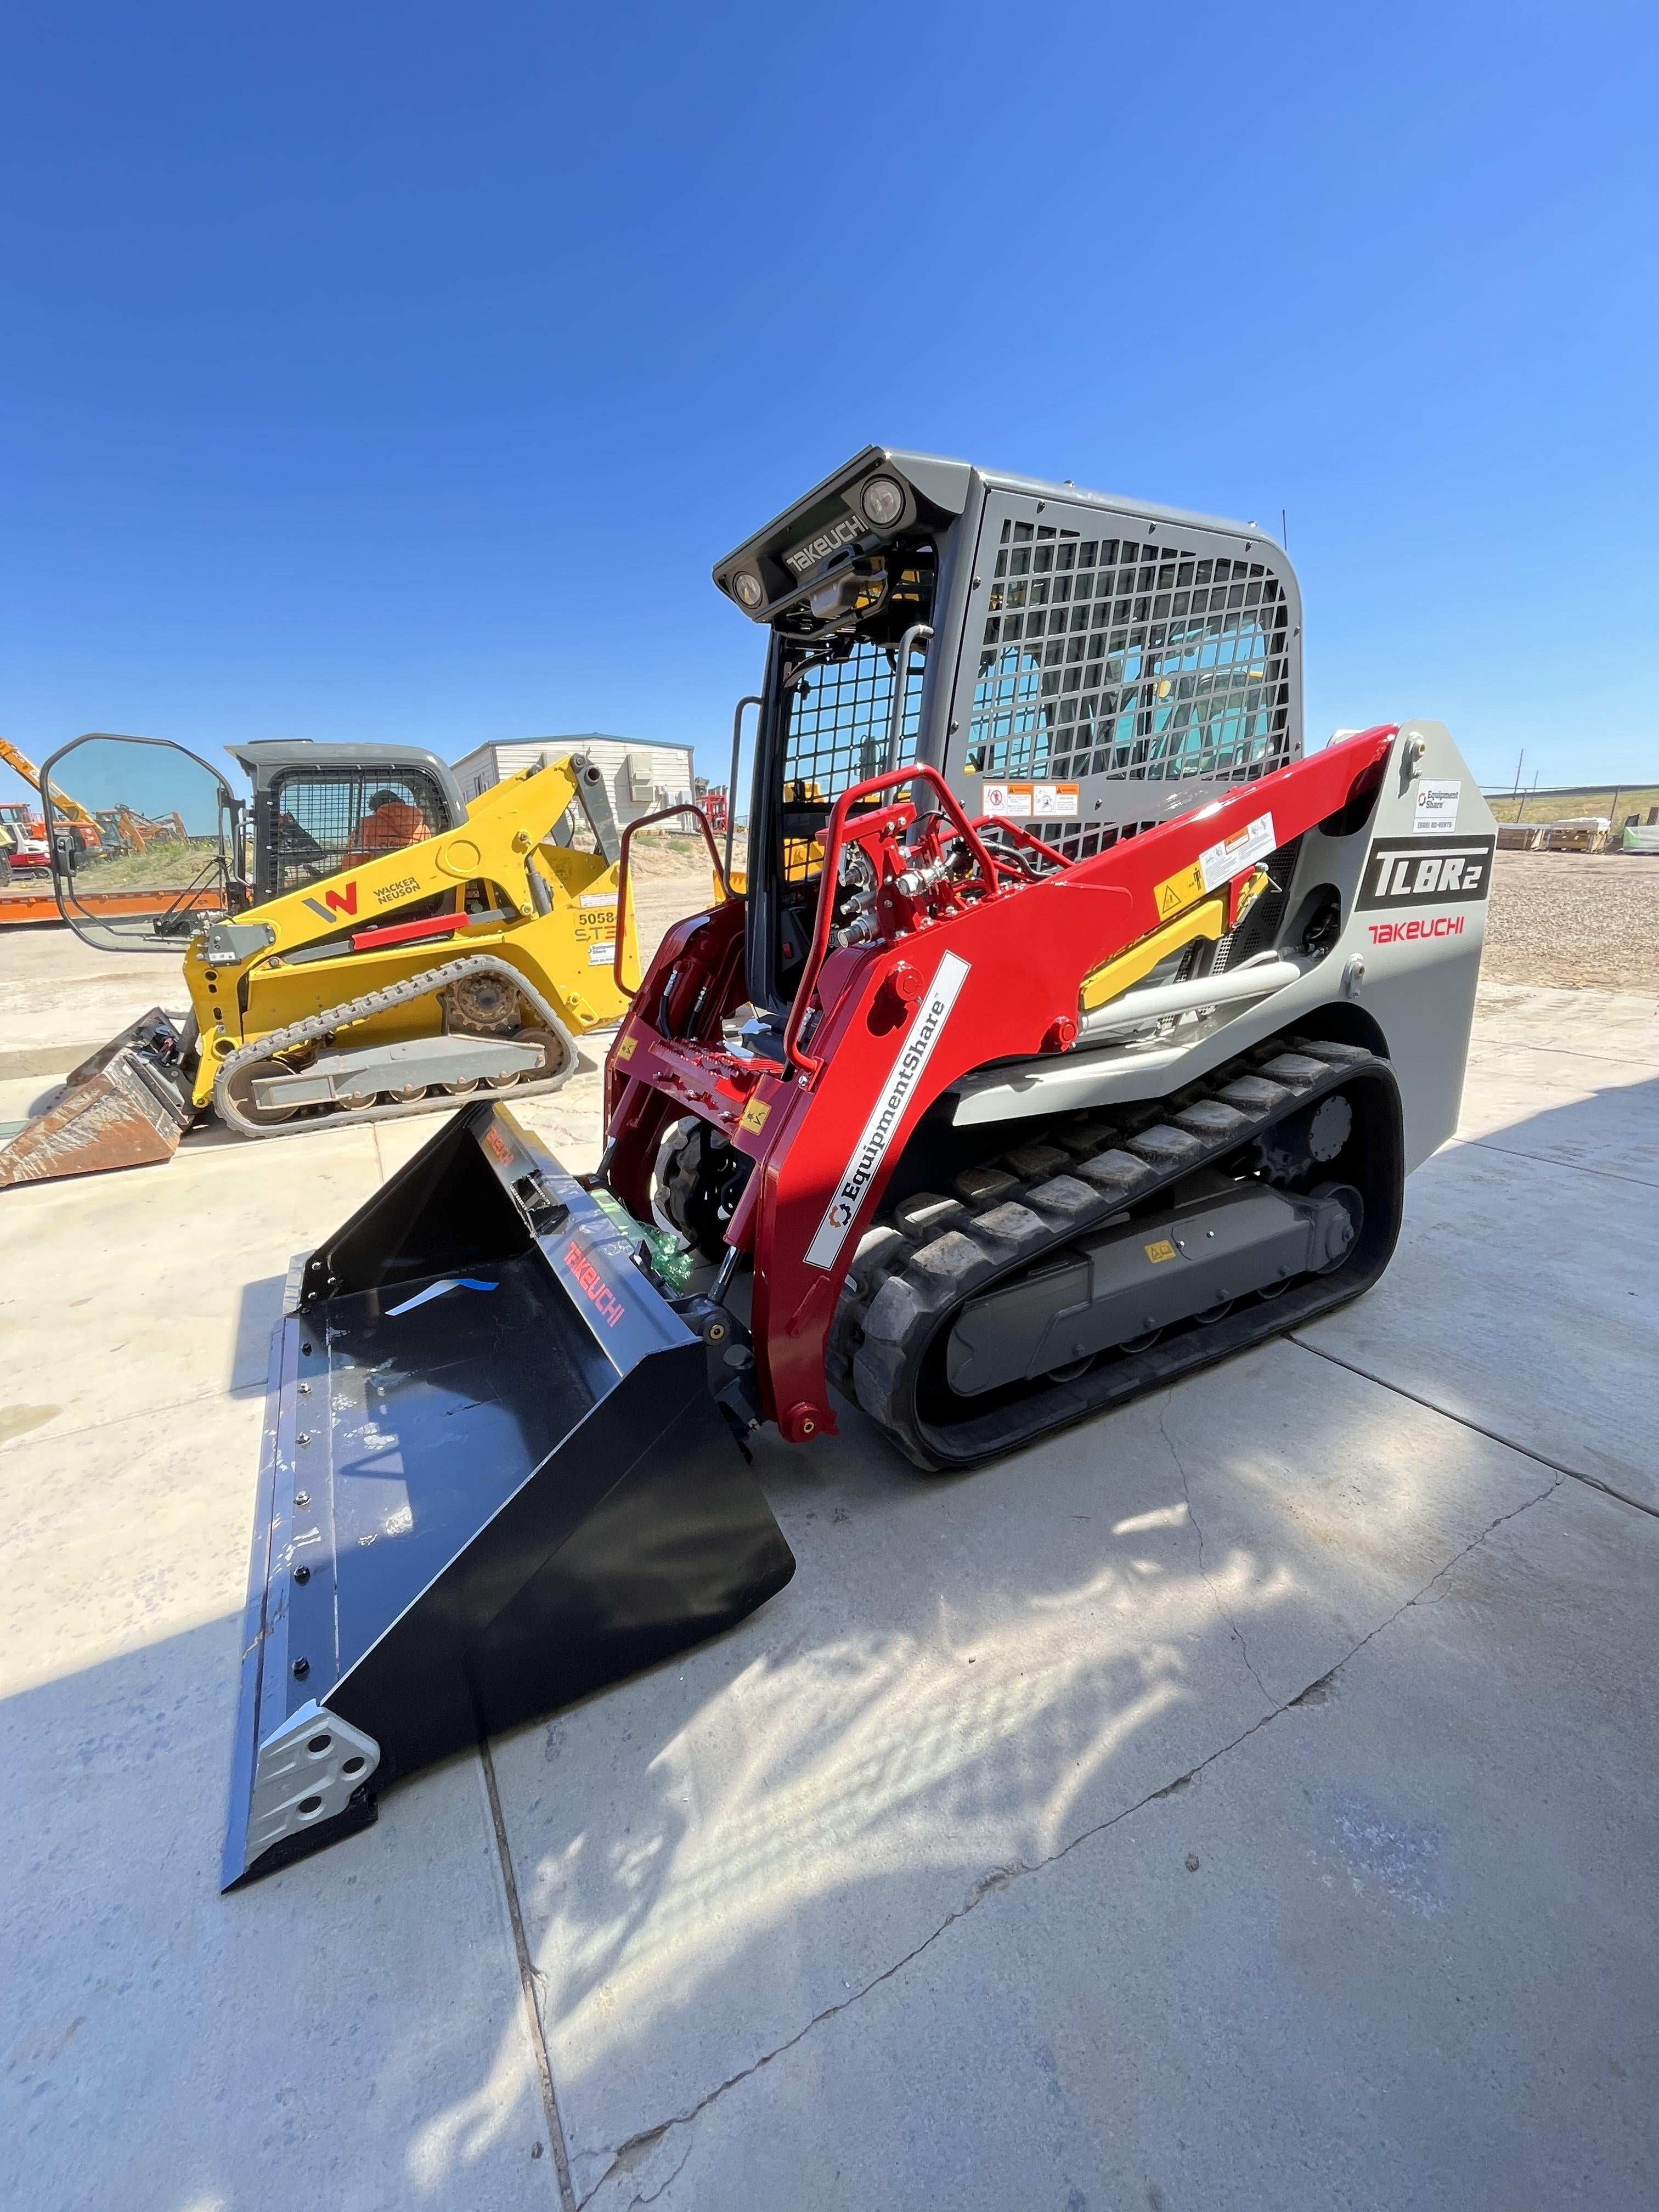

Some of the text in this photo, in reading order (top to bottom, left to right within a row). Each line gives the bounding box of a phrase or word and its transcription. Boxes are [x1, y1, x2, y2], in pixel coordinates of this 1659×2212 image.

[1427, 791, 1459, 800] Equipment
[1375, 847, 1489, 896] TL8R2
[373, 877, 417, 896] WACKER
[378, 883, 421, 904] NEUSON
[1368, 916, 1464, 944] TAKEUCHI
[841, 1001, 945, 1201] EquipmentShare
